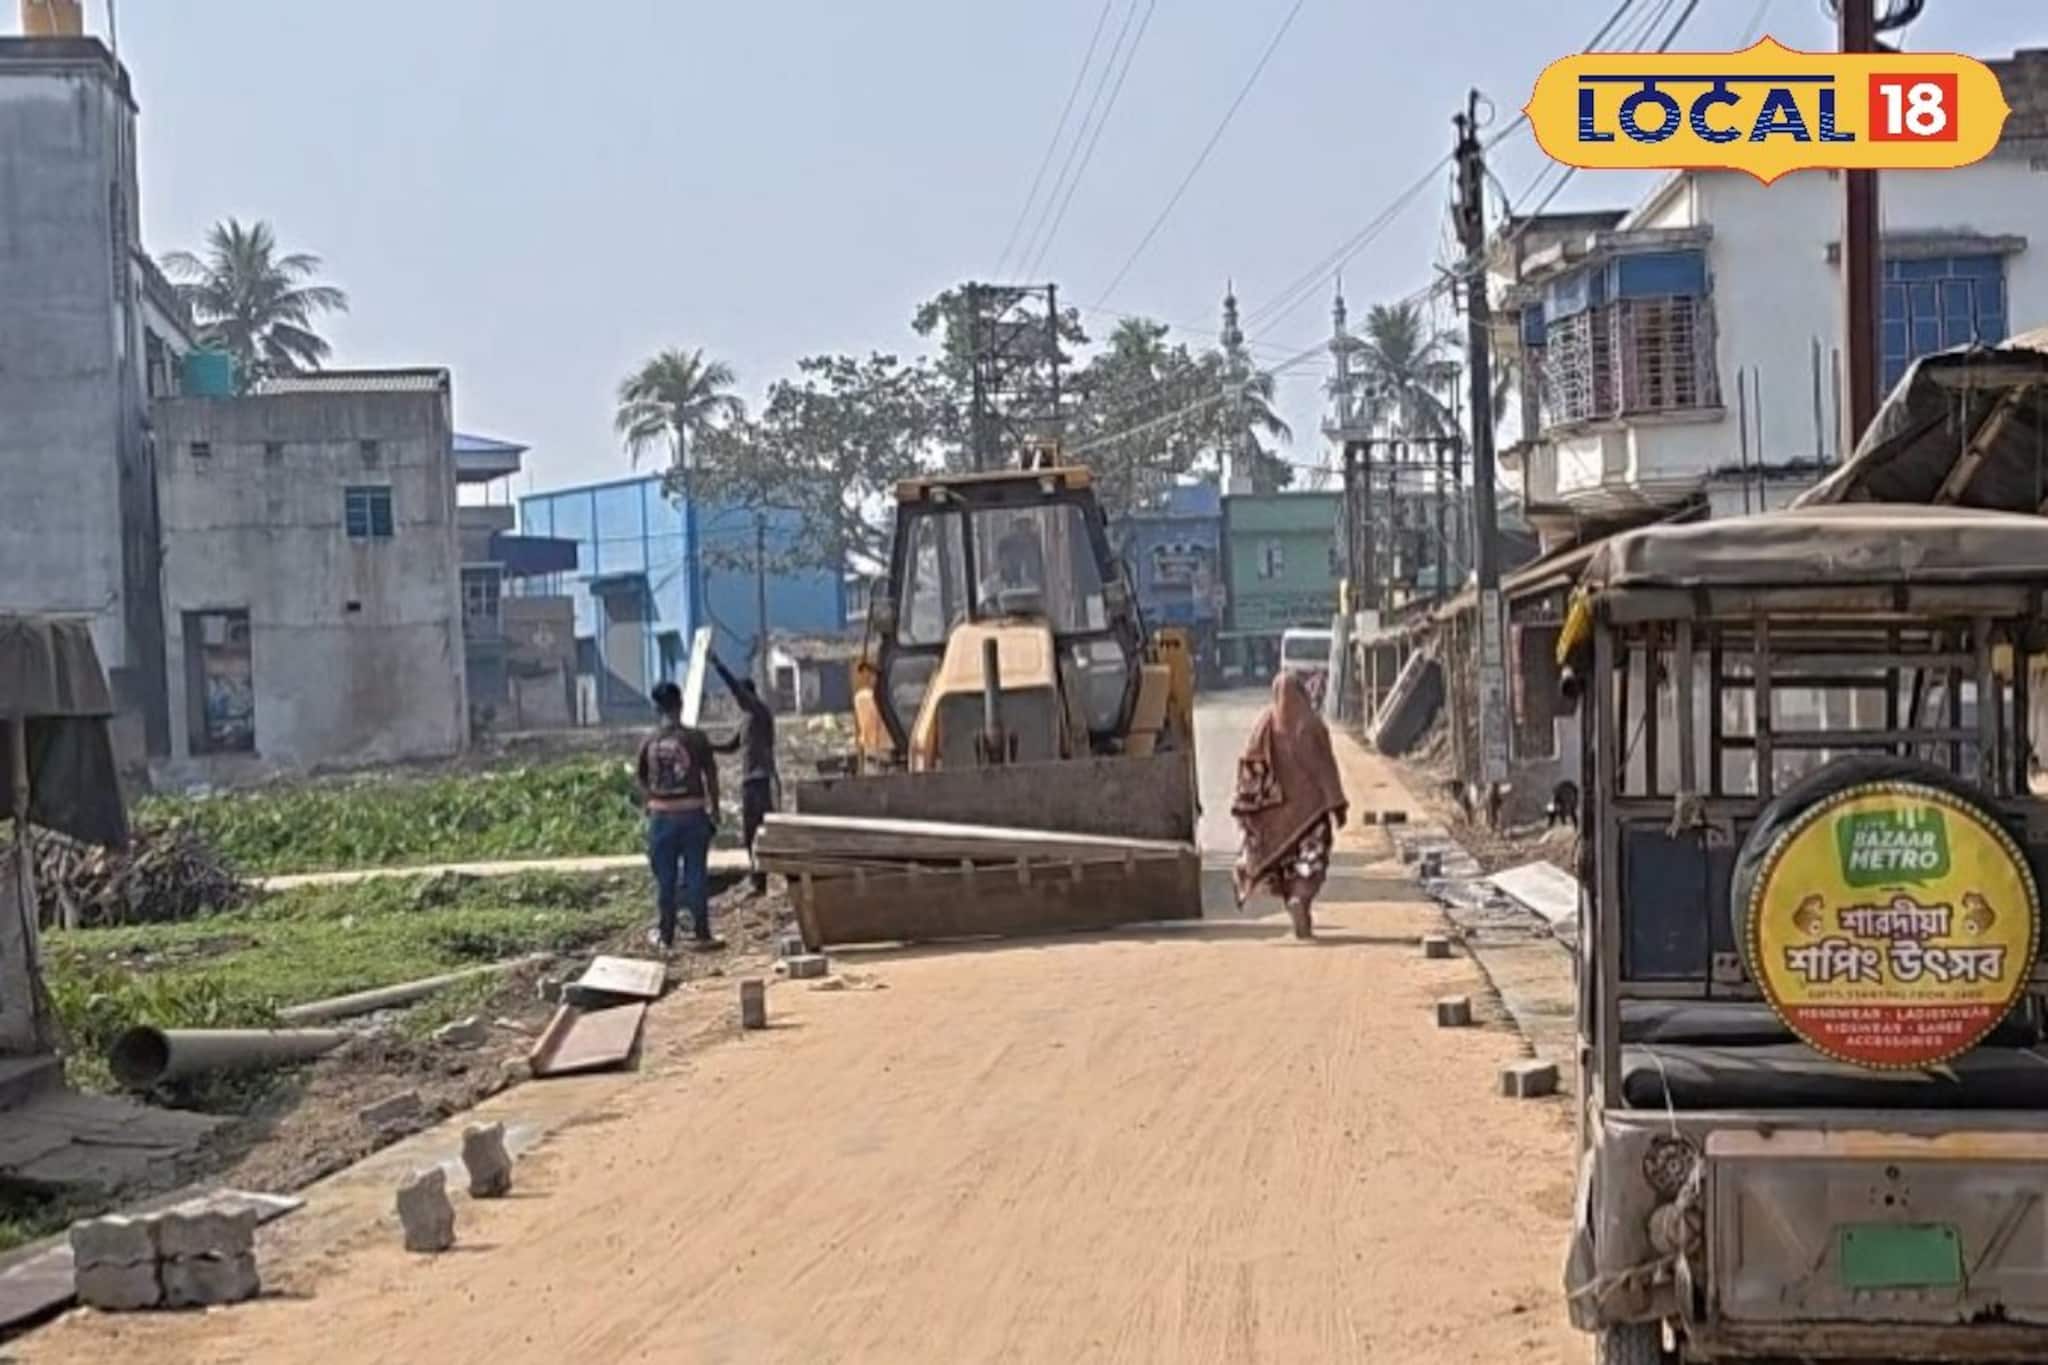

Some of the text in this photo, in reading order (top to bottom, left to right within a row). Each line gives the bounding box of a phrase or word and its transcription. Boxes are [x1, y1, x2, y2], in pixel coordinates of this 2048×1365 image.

[1853, 831, 1936, 849] BAZAAR
[1849, 849, 1939, 870] METRO
[1840, 896, 1951, 938] শারদীয়া
[1787, 937, 2004, 983] শপিং উৎসব
